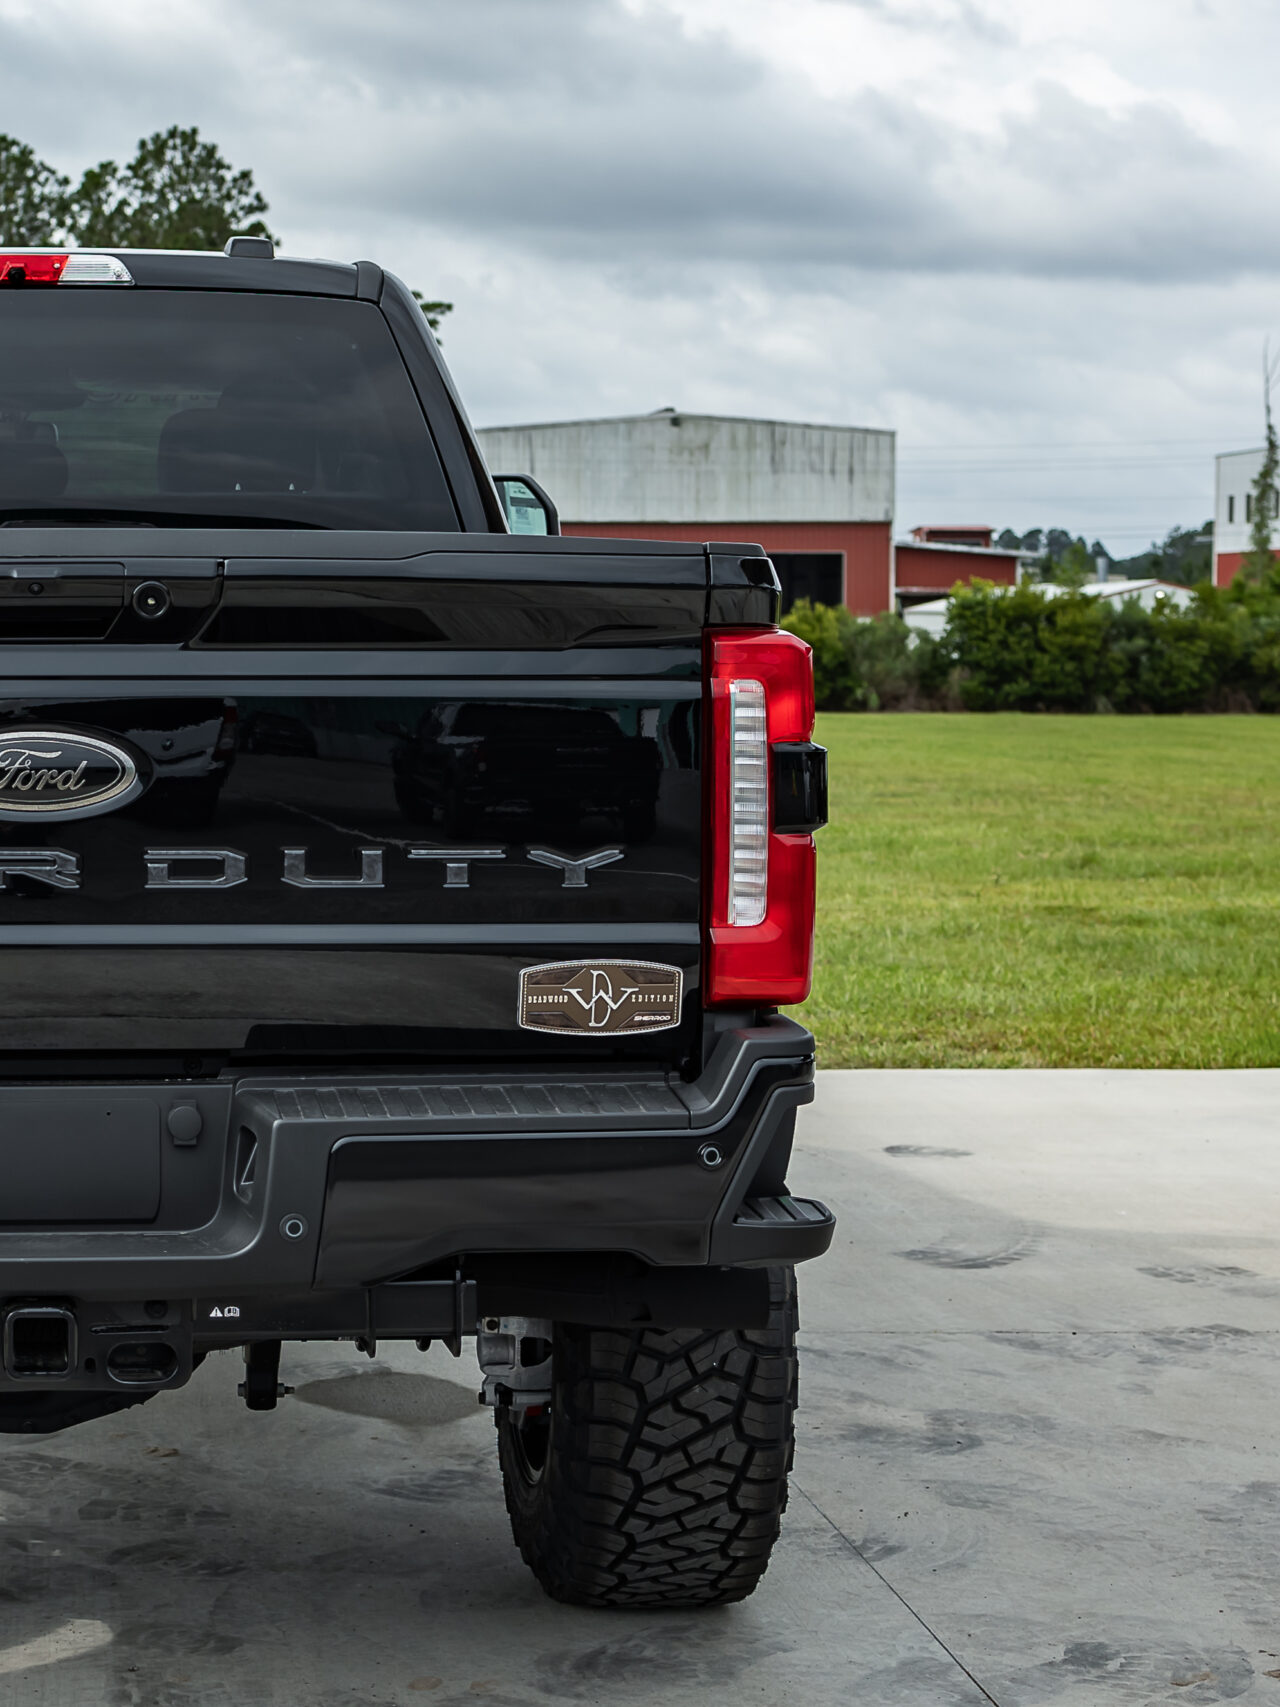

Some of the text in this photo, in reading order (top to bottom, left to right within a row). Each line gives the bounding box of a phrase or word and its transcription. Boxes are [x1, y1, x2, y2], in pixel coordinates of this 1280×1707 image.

[144, 847, 624, 888] DUTY
[527, 994, 674, 1004] DEADWOOD EDITION
